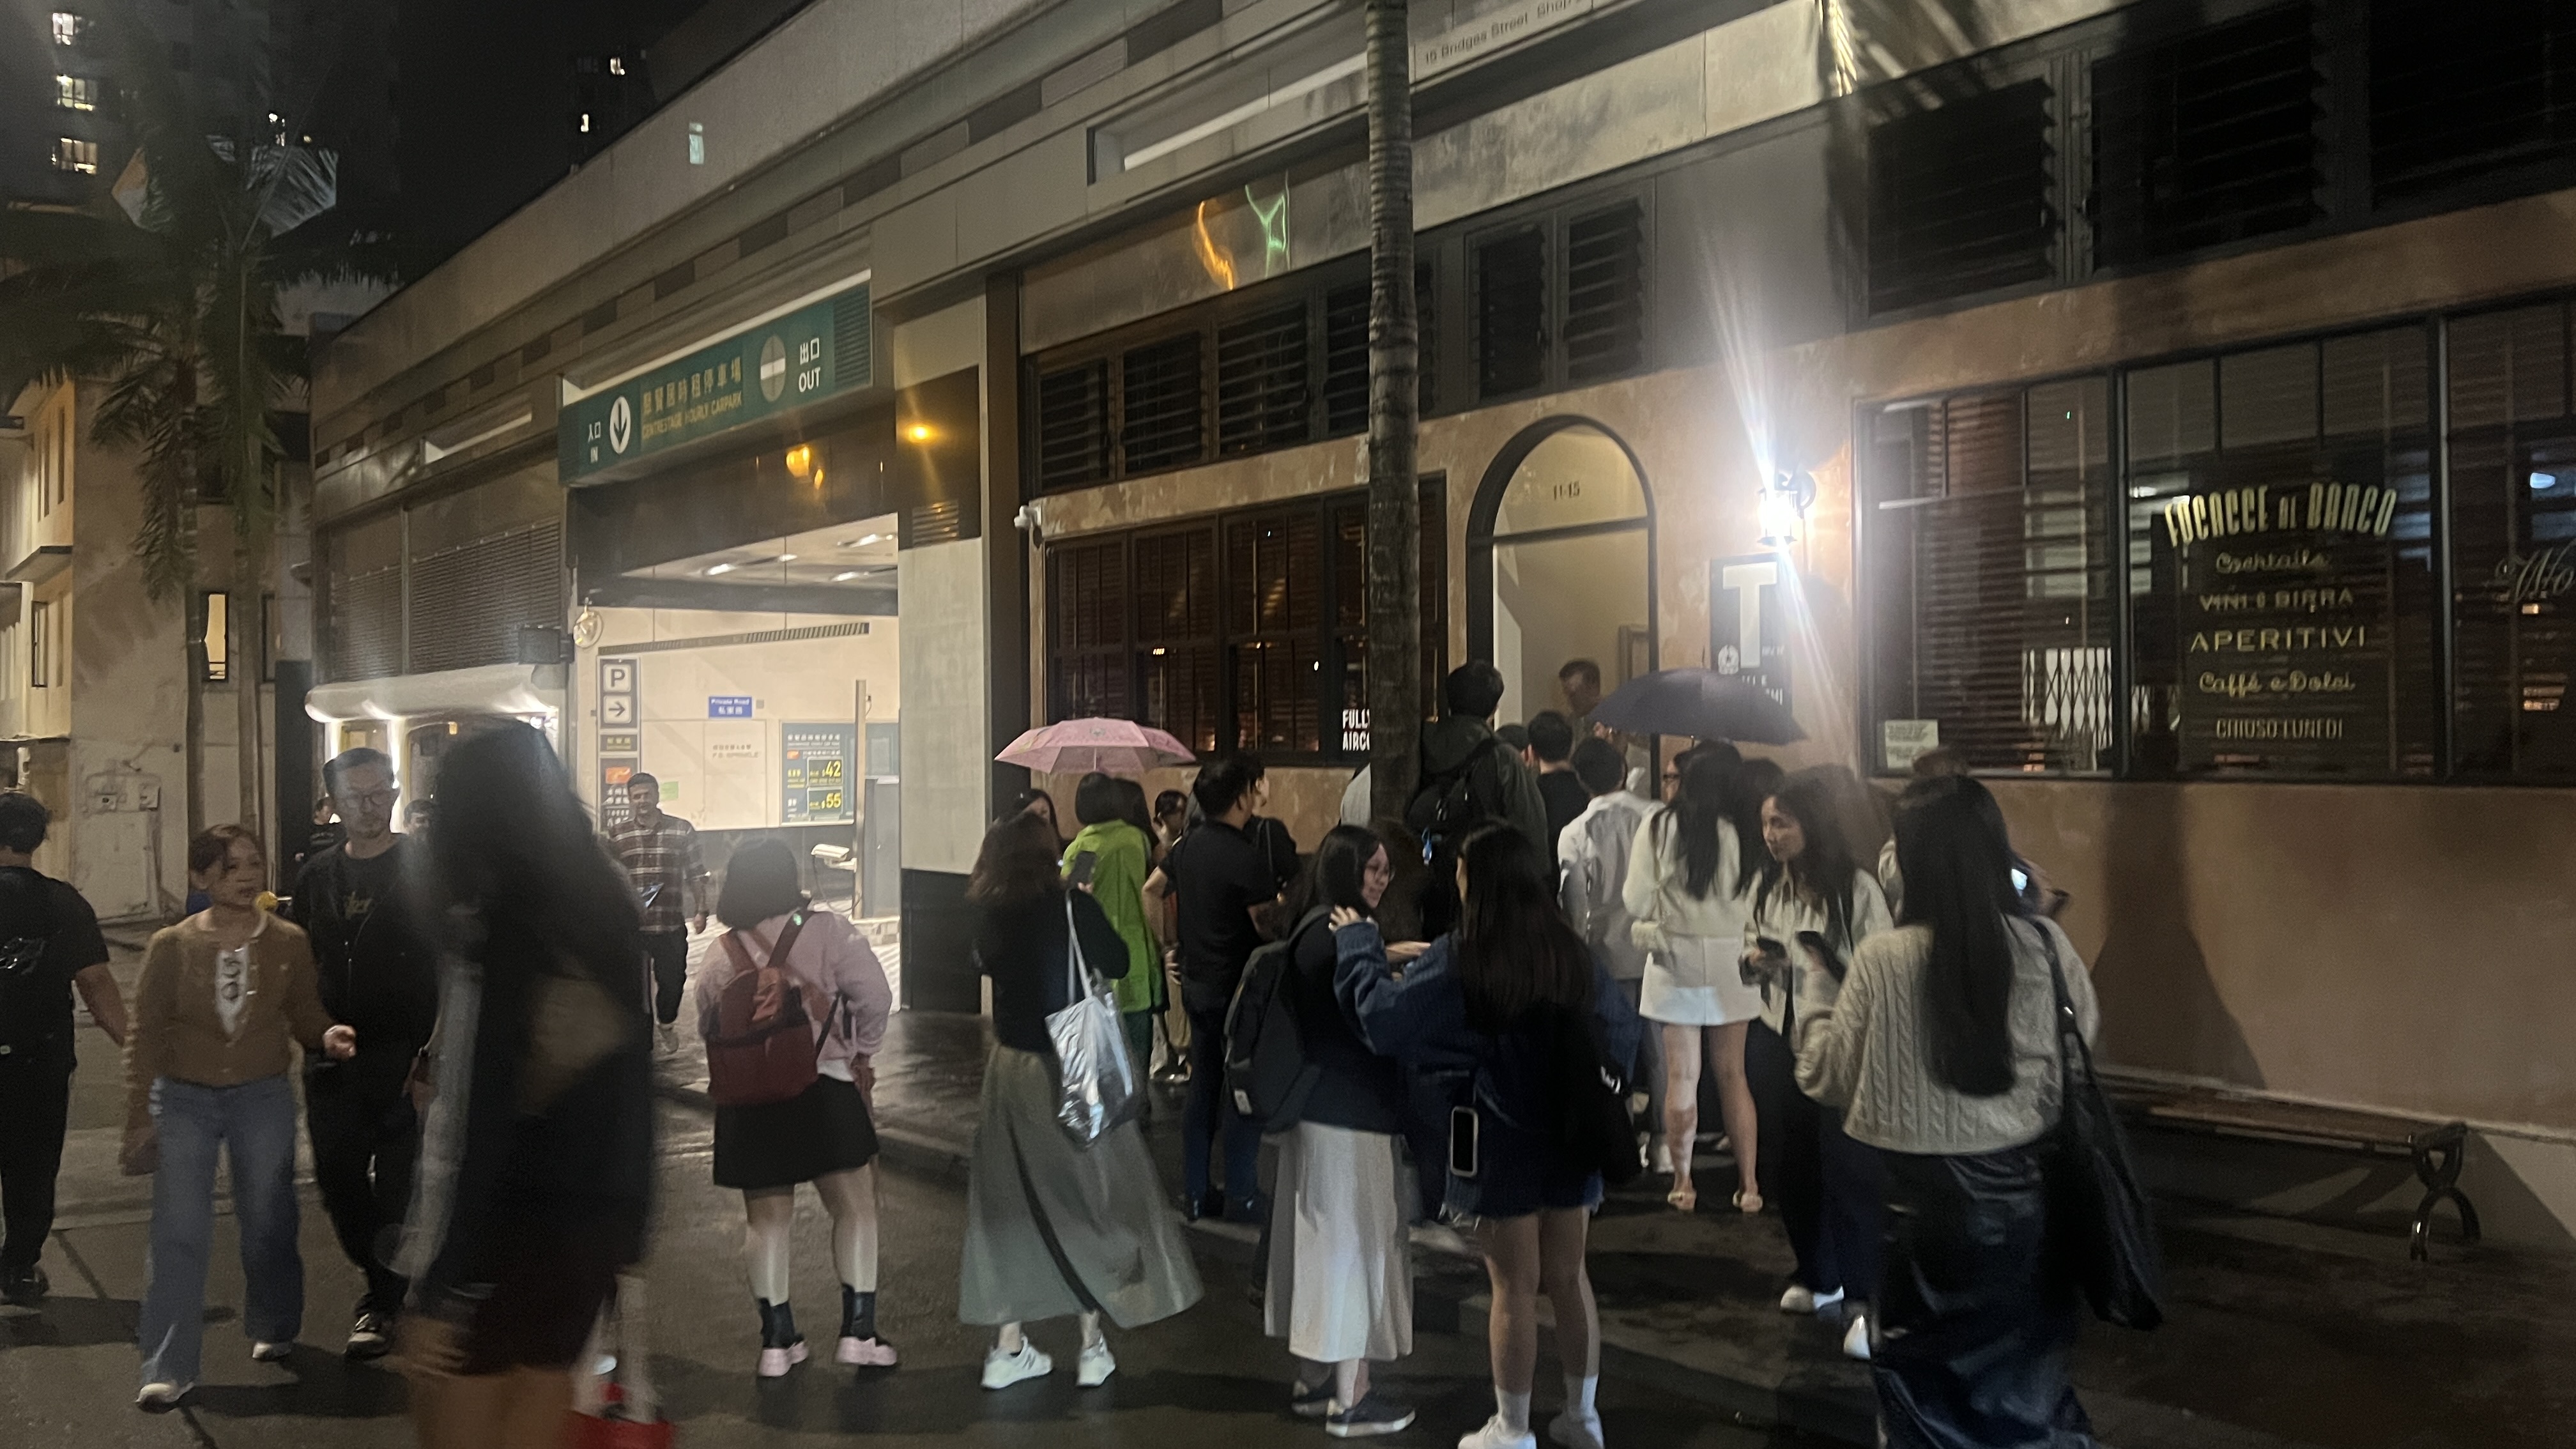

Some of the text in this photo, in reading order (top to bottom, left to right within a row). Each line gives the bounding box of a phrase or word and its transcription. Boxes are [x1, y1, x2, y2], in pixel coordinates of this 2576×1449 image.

[1441, 32, 1487, 58] Bridges
[1491, 12, 1528, 38] Street
[799, 337, 820, 365] 出口
[799, 366, 821, 393] OUT
[588, 421, 601, 443] 入口
[2165, 484, 2269, 548] FOCACCE
[2200, 592, 2248, 611] VINI
[2274, 586, 2354, 608] BIRRA
[1723, 560, 1777, 669] T
[2190, 624, 2365, 653] APERITIVI
[611, 668, 625, 687] P
